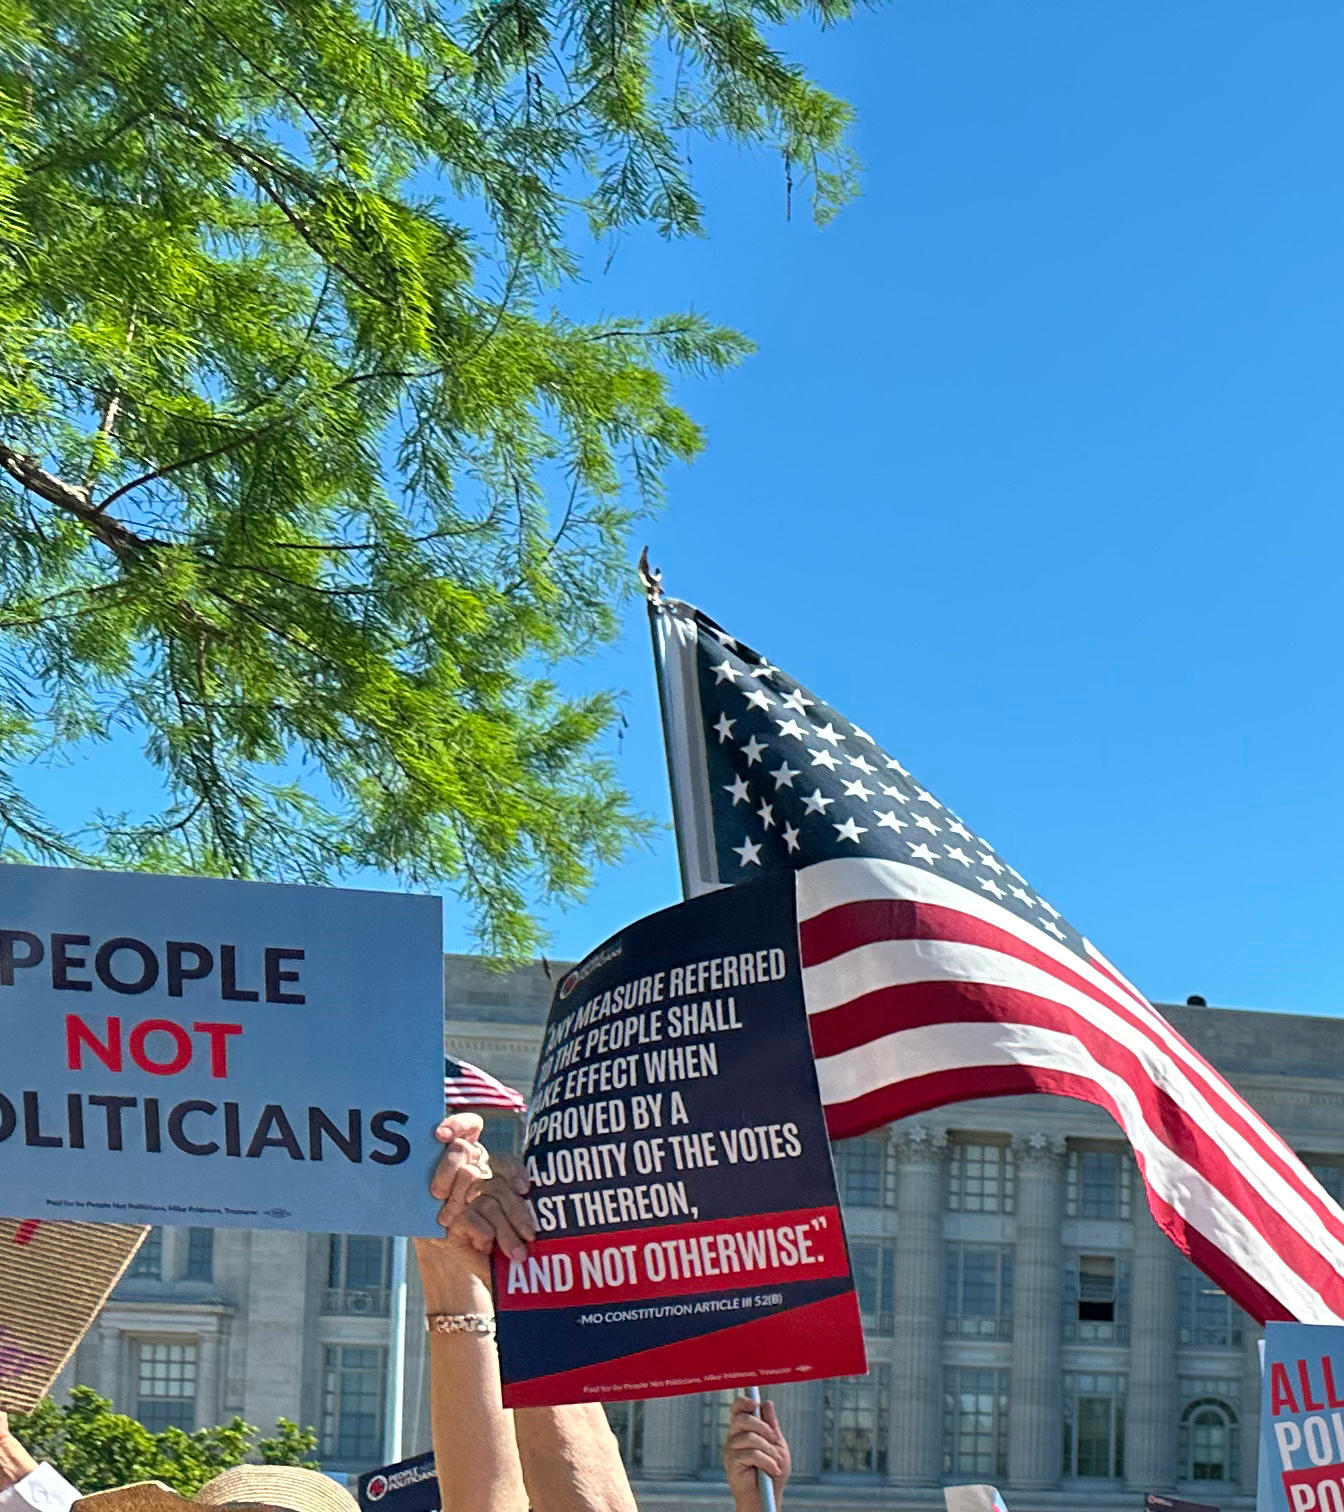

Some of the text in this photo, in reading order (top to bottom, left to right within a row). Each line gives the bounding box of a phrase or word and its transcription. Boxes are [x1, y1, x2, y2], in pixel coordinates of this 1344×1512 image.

[0, 929, 306, 1005] PEOPLE
[574, 975, 664, 1033] MEASURE
[669, 948, 786, 998] REFERRED
[65, 1015, 242, 1079] NOT
[586, 998, 742, 1059] PEOPLE SHALL
[564, 1042, 718, 1100] EFFECT WHEN
[0, 1091, 410, 1165] LITICIANS
[720, 1122, 801, 1163] VOTES
[566, 1181, 699, 1228] THEREON,
[508, 1252, 574, 1294] AND
[581, 1246, 637, 1289] NOT
[605, 1303, 692, 1323] CONSTITUTION
